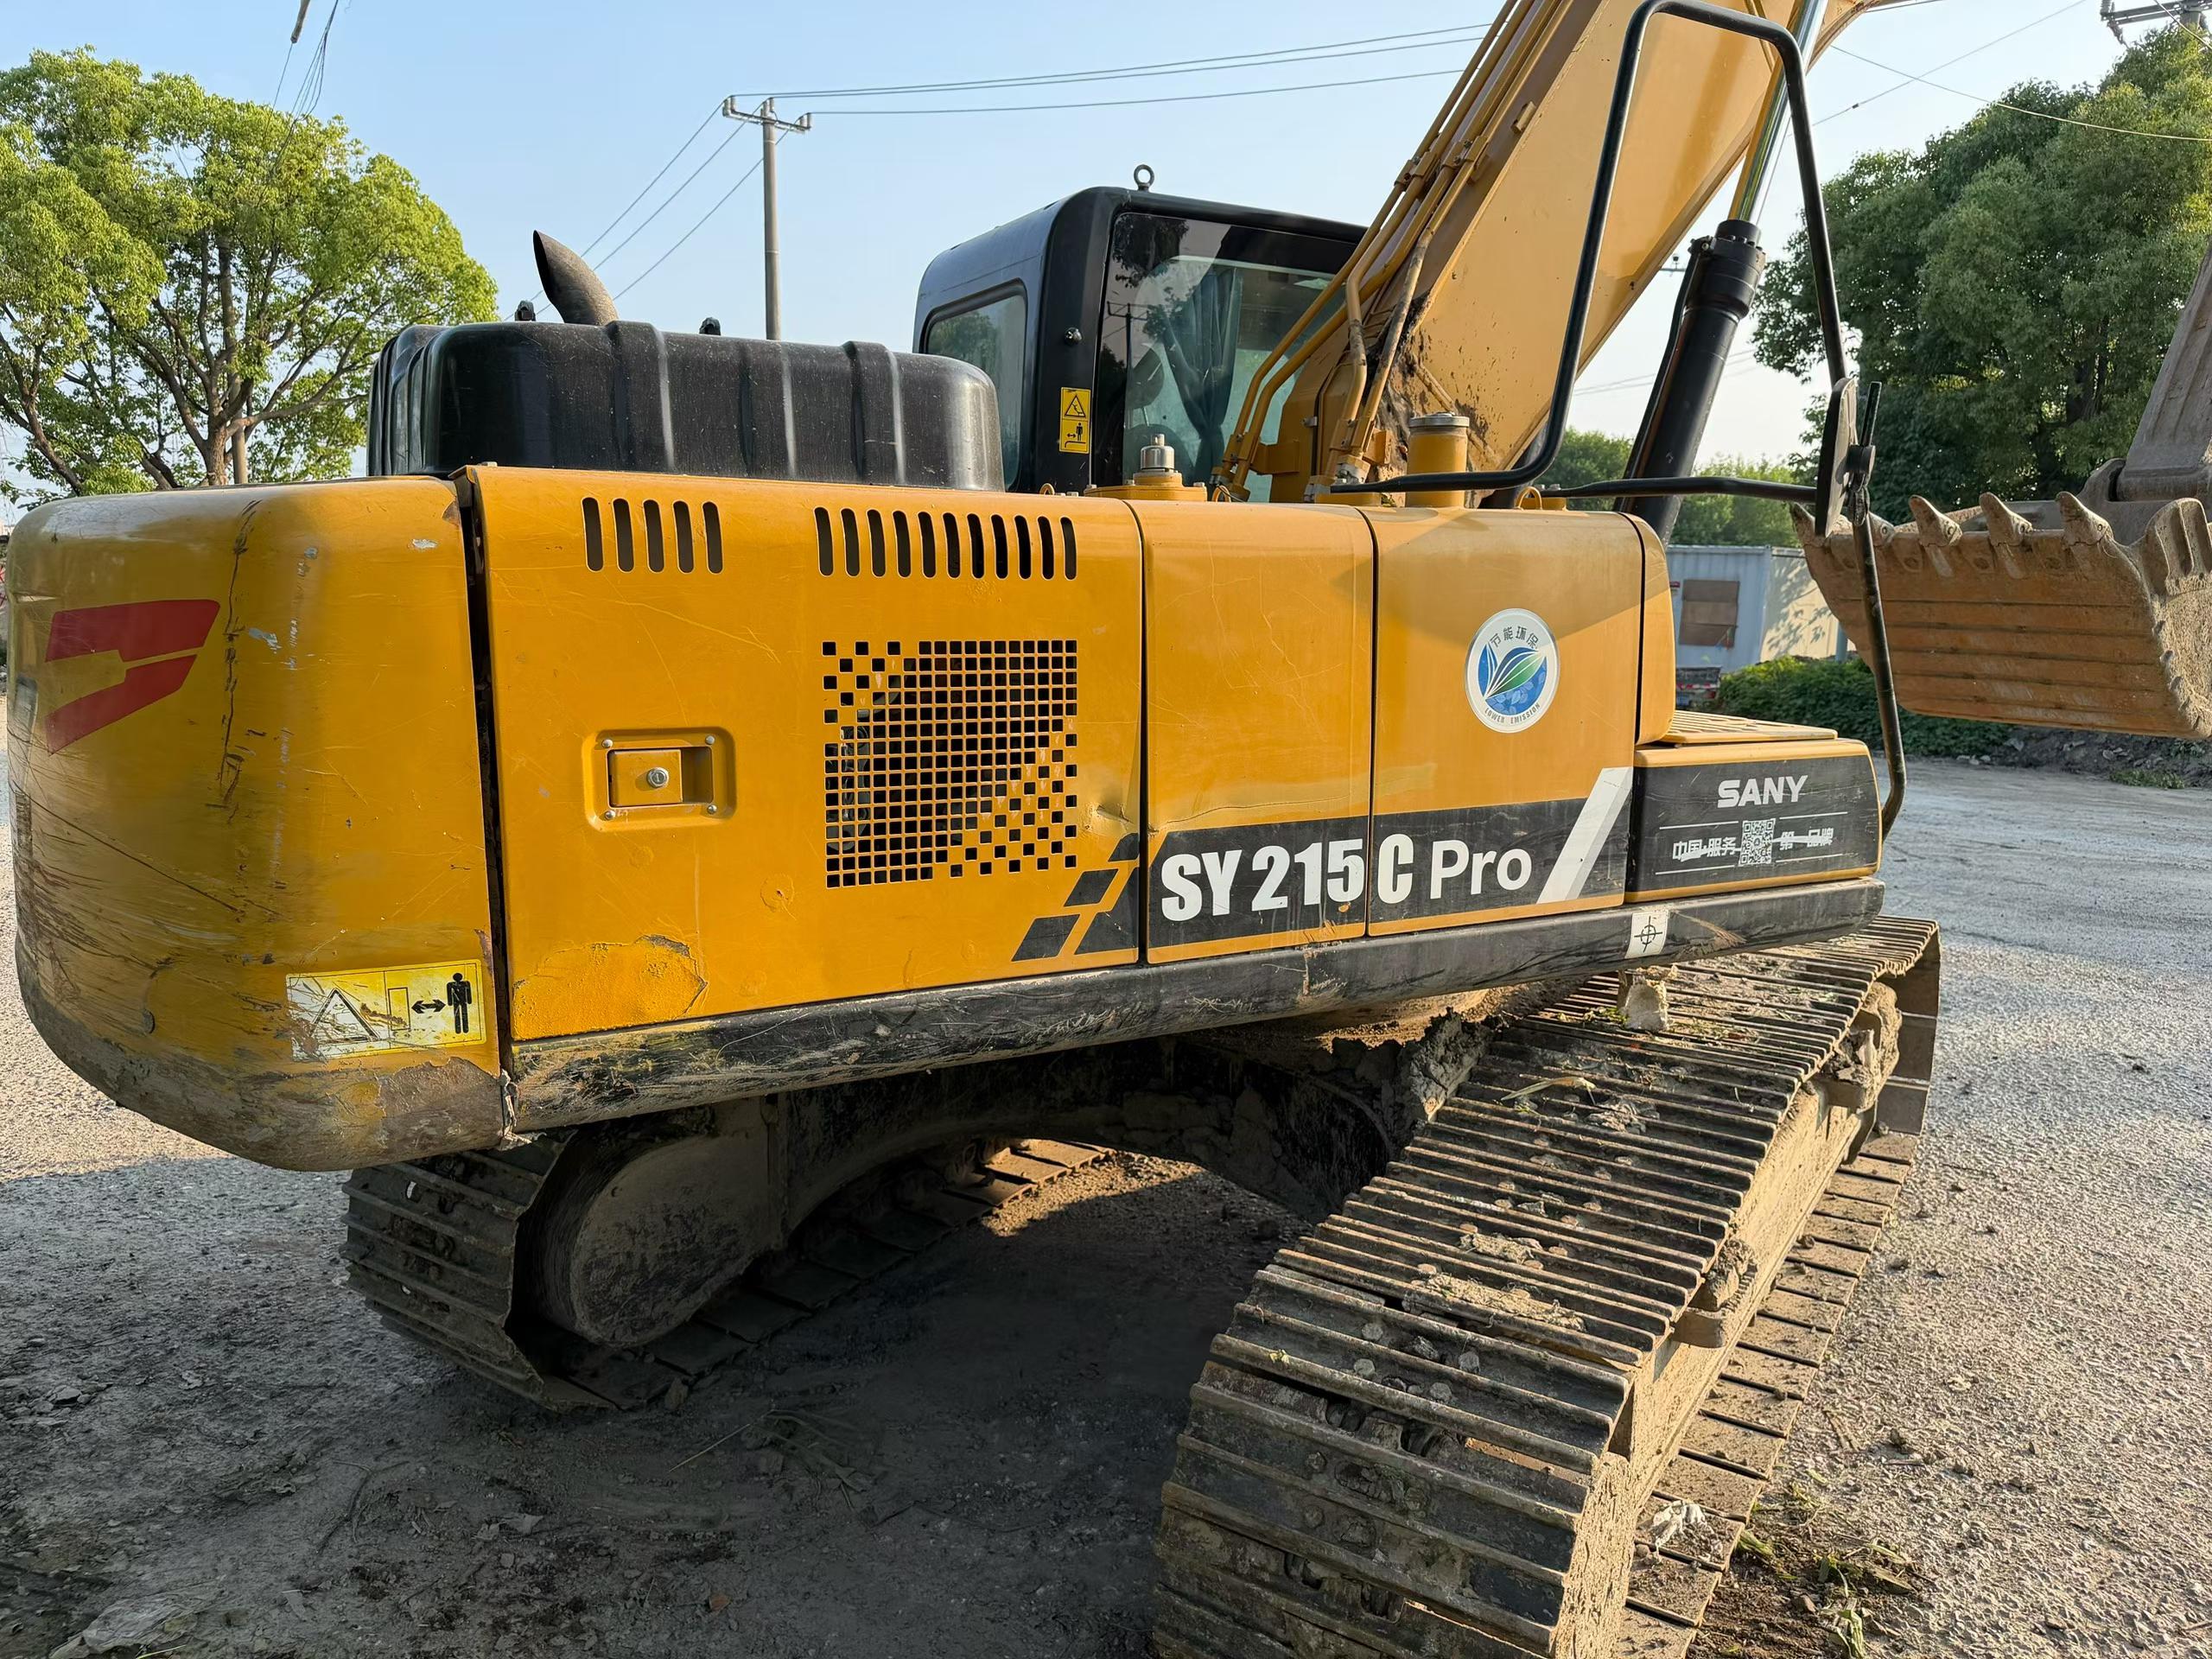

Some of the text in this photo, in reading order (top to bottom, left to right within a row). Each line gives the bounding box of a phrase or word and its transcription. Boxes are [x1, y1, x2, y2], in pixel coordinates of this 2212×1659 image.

[1490, 626, 1540, 649] 节能环保
[1484, 702, 1541, 724] LOWER EMISSION
[1717, 775, 1808, 809] SANY
[1430, 839, 1533, 899] Pro
